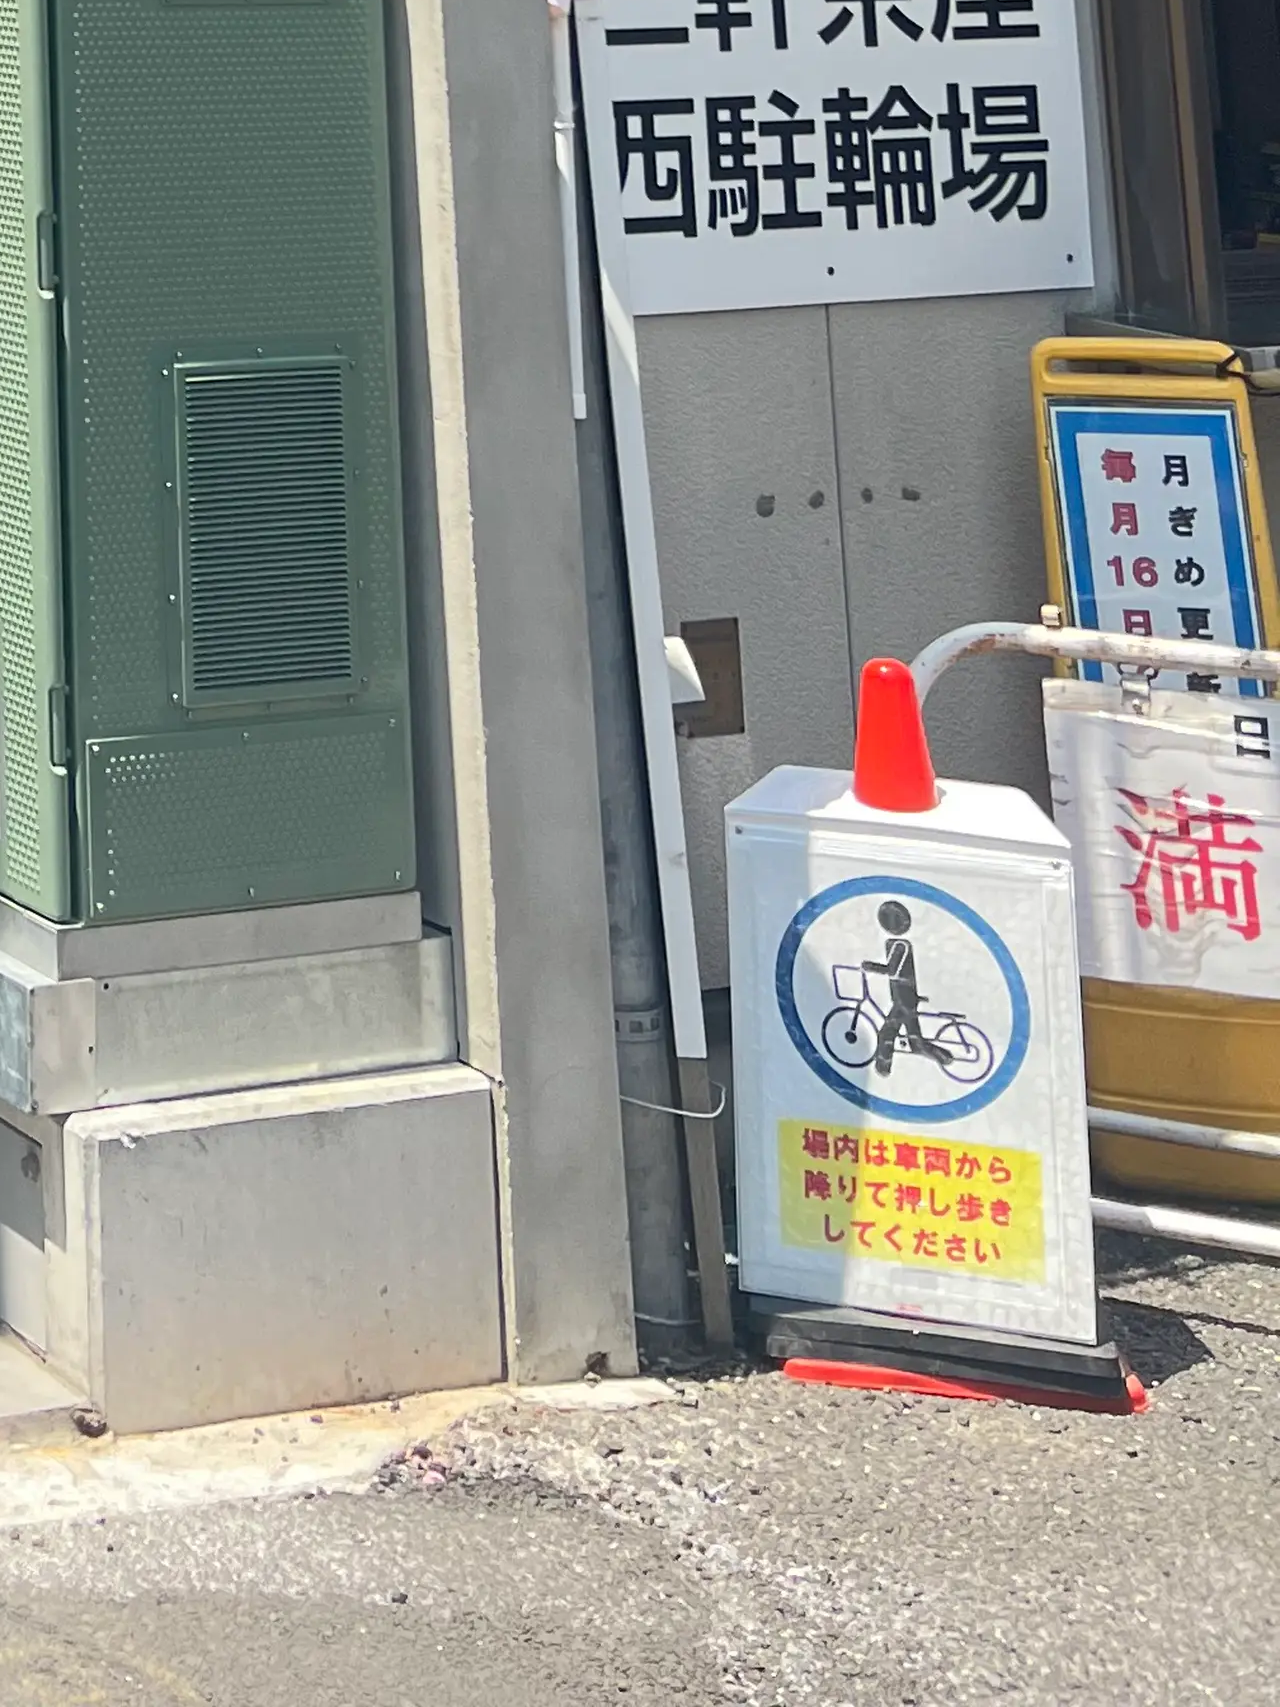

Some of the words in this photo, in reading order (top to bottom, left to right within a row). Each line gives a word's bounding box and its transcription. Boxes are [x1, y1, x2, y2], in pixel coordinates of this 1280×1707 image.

[612, 82, 1049, 238] 西駐輪場
[823, 1213, 1002, 1265] してください
